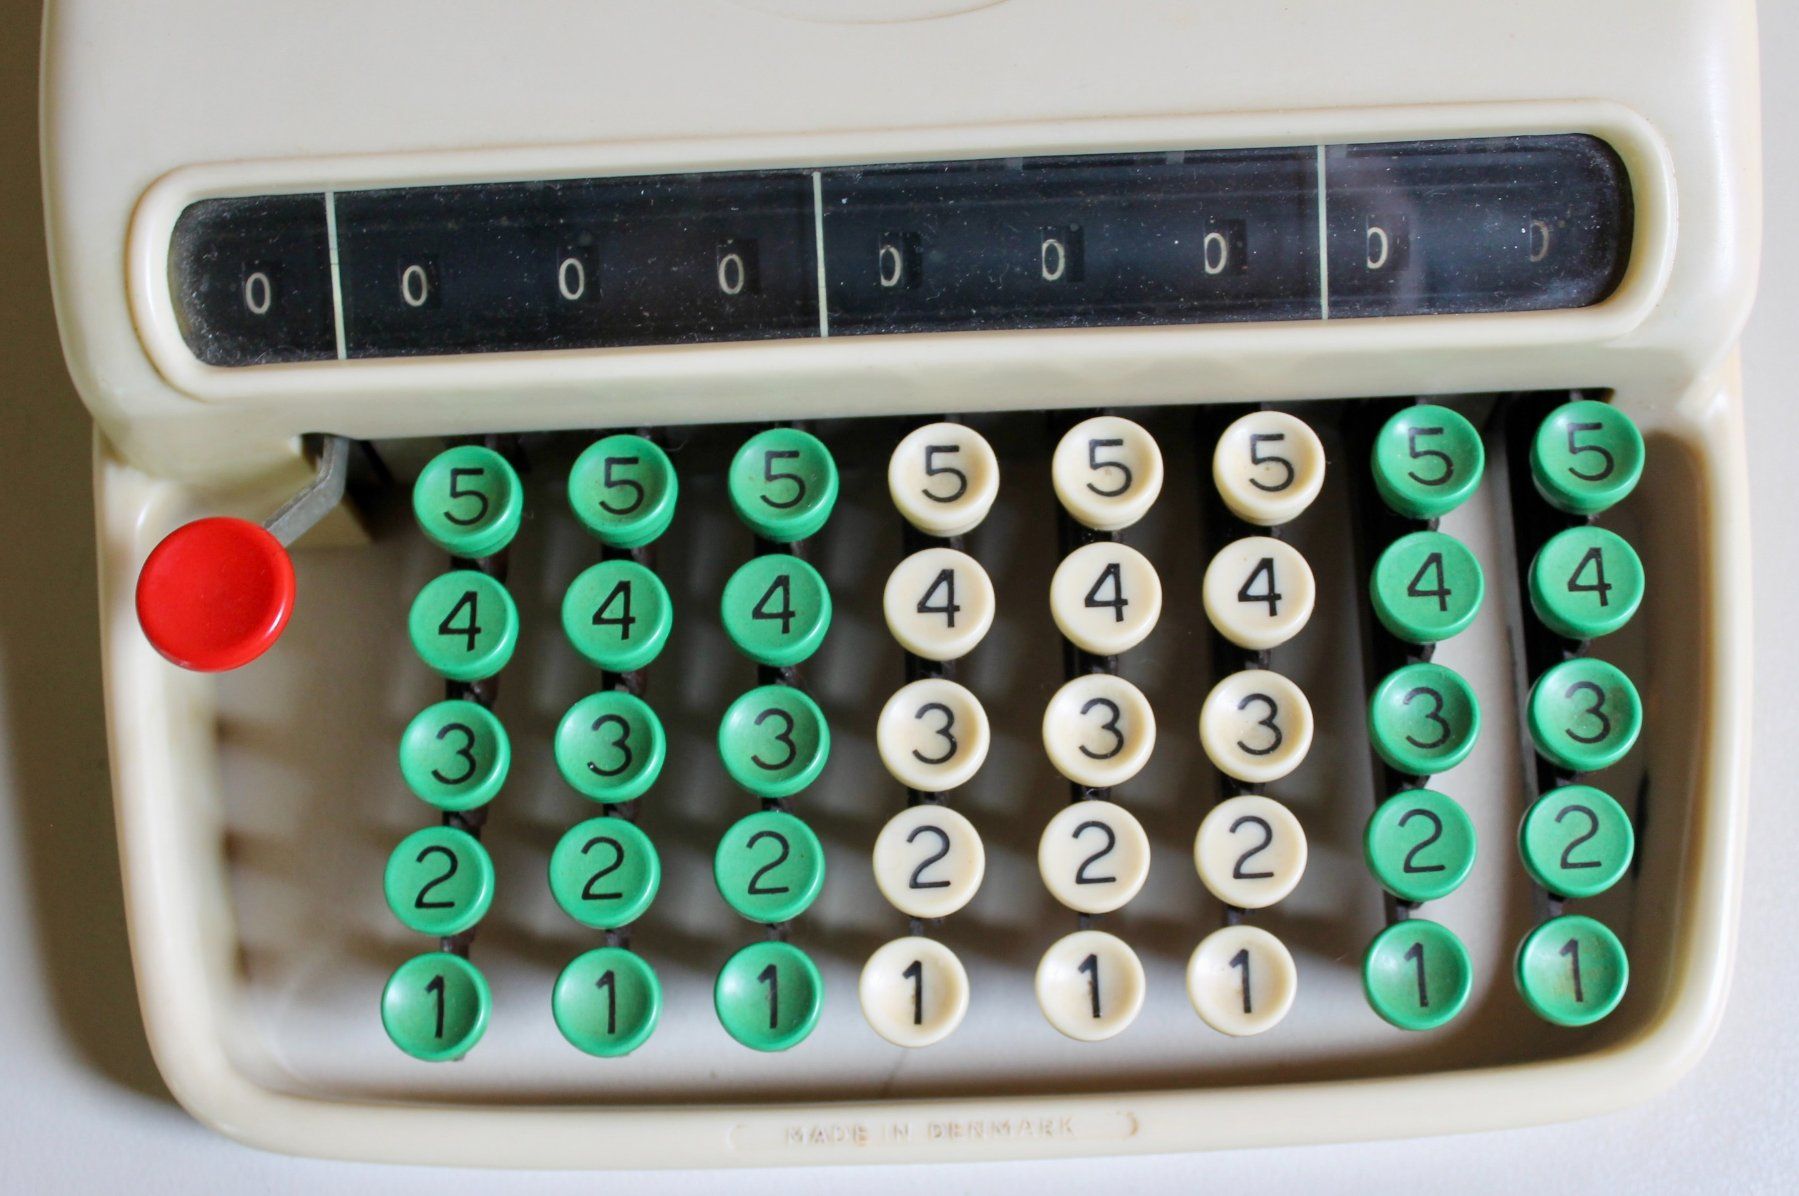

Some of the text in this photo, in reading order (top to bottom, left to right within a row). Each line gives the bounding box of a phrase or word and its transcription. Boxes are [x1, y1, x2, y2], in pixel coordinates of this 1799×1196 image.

[246, 273, 270, 314] 0
[402, 265, 427, 306] 0
[559, 258, 584, 300] 0
[718, 254, 744, 294] 0
[881, 245, 902, 286] 0
[1042, 239, 1065, 281] 0
[1204, 233, 1227, 274] 0
[1367, 227, 1388, 269] 0
[444, 422, 1614, 526] 5 5 5 5 5 5 5 5
[438, 548, 1612, 651] 4 4 4 4 4 4 4 4
[431, 681, 1611, 785] 3 3 3 3 3 3 3 3
[415, 805, 1602, 909] 2 2 2 2 2 2 2 2
[424, 938, 1584, 1038] 1 1 1 1 1 1 1 1
[785, 1115, 1075, 1147] MADE IN DENMARK
